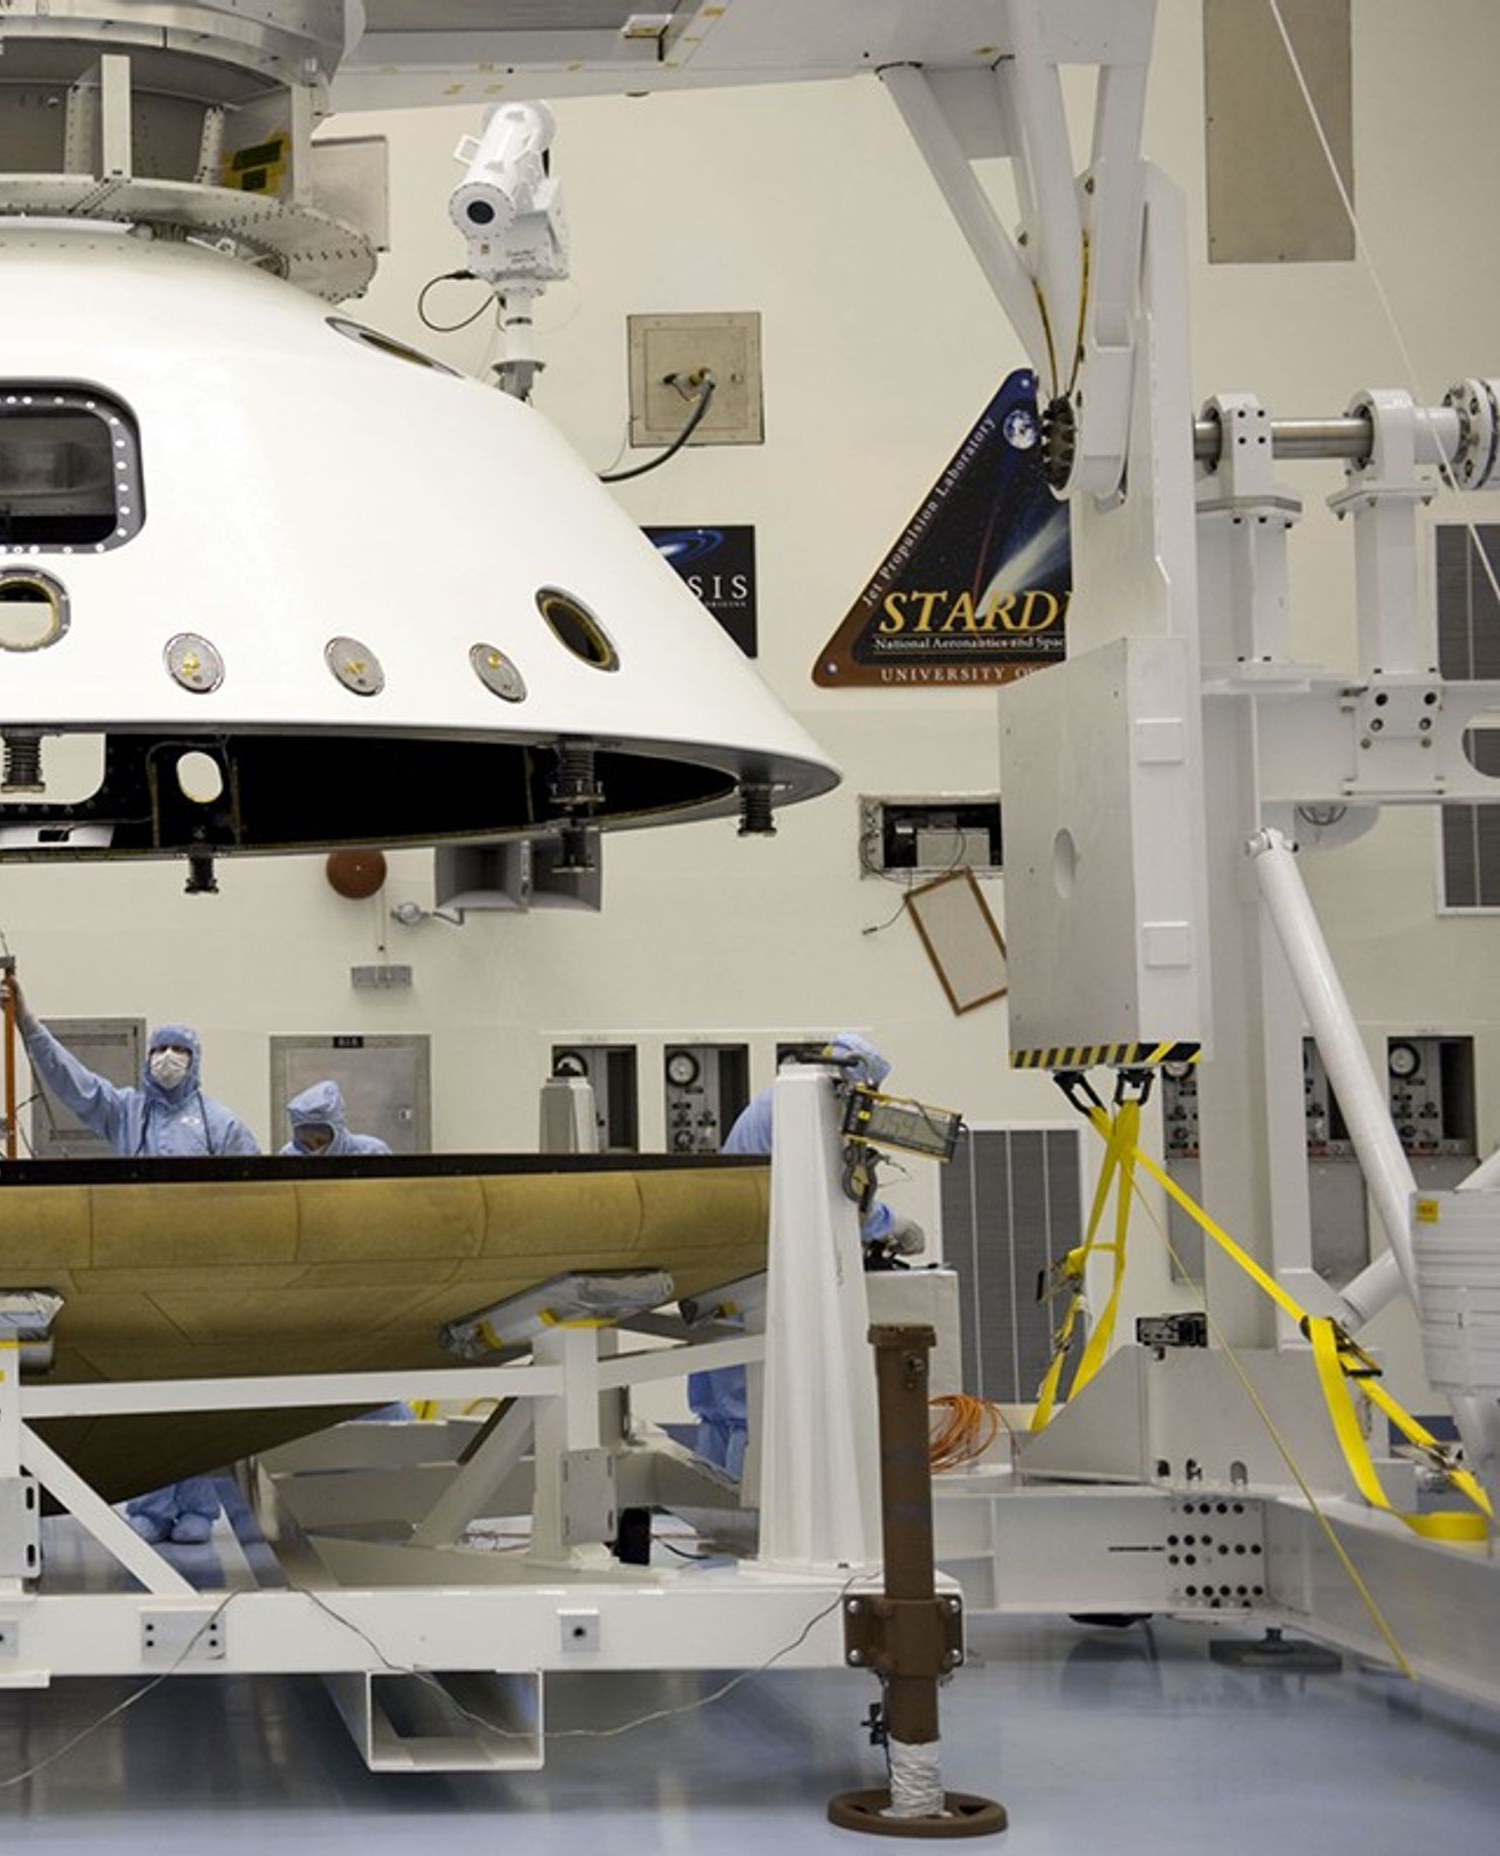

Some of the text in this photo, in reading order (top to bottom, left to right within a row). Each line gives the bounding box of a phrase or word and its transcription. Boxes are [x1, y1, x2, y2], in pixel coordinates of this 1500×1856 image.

[862, 416, 996, 606] Jet Propulsion Laboratory
[878, 590, 1071, 633] STARD
[875, 637, 929, 649] National
[933, 637, 1008, 649] Aeronautics
[1010, 636, 1034, 649] and
[880, 668, 1005, 681] UNIVERSITY
